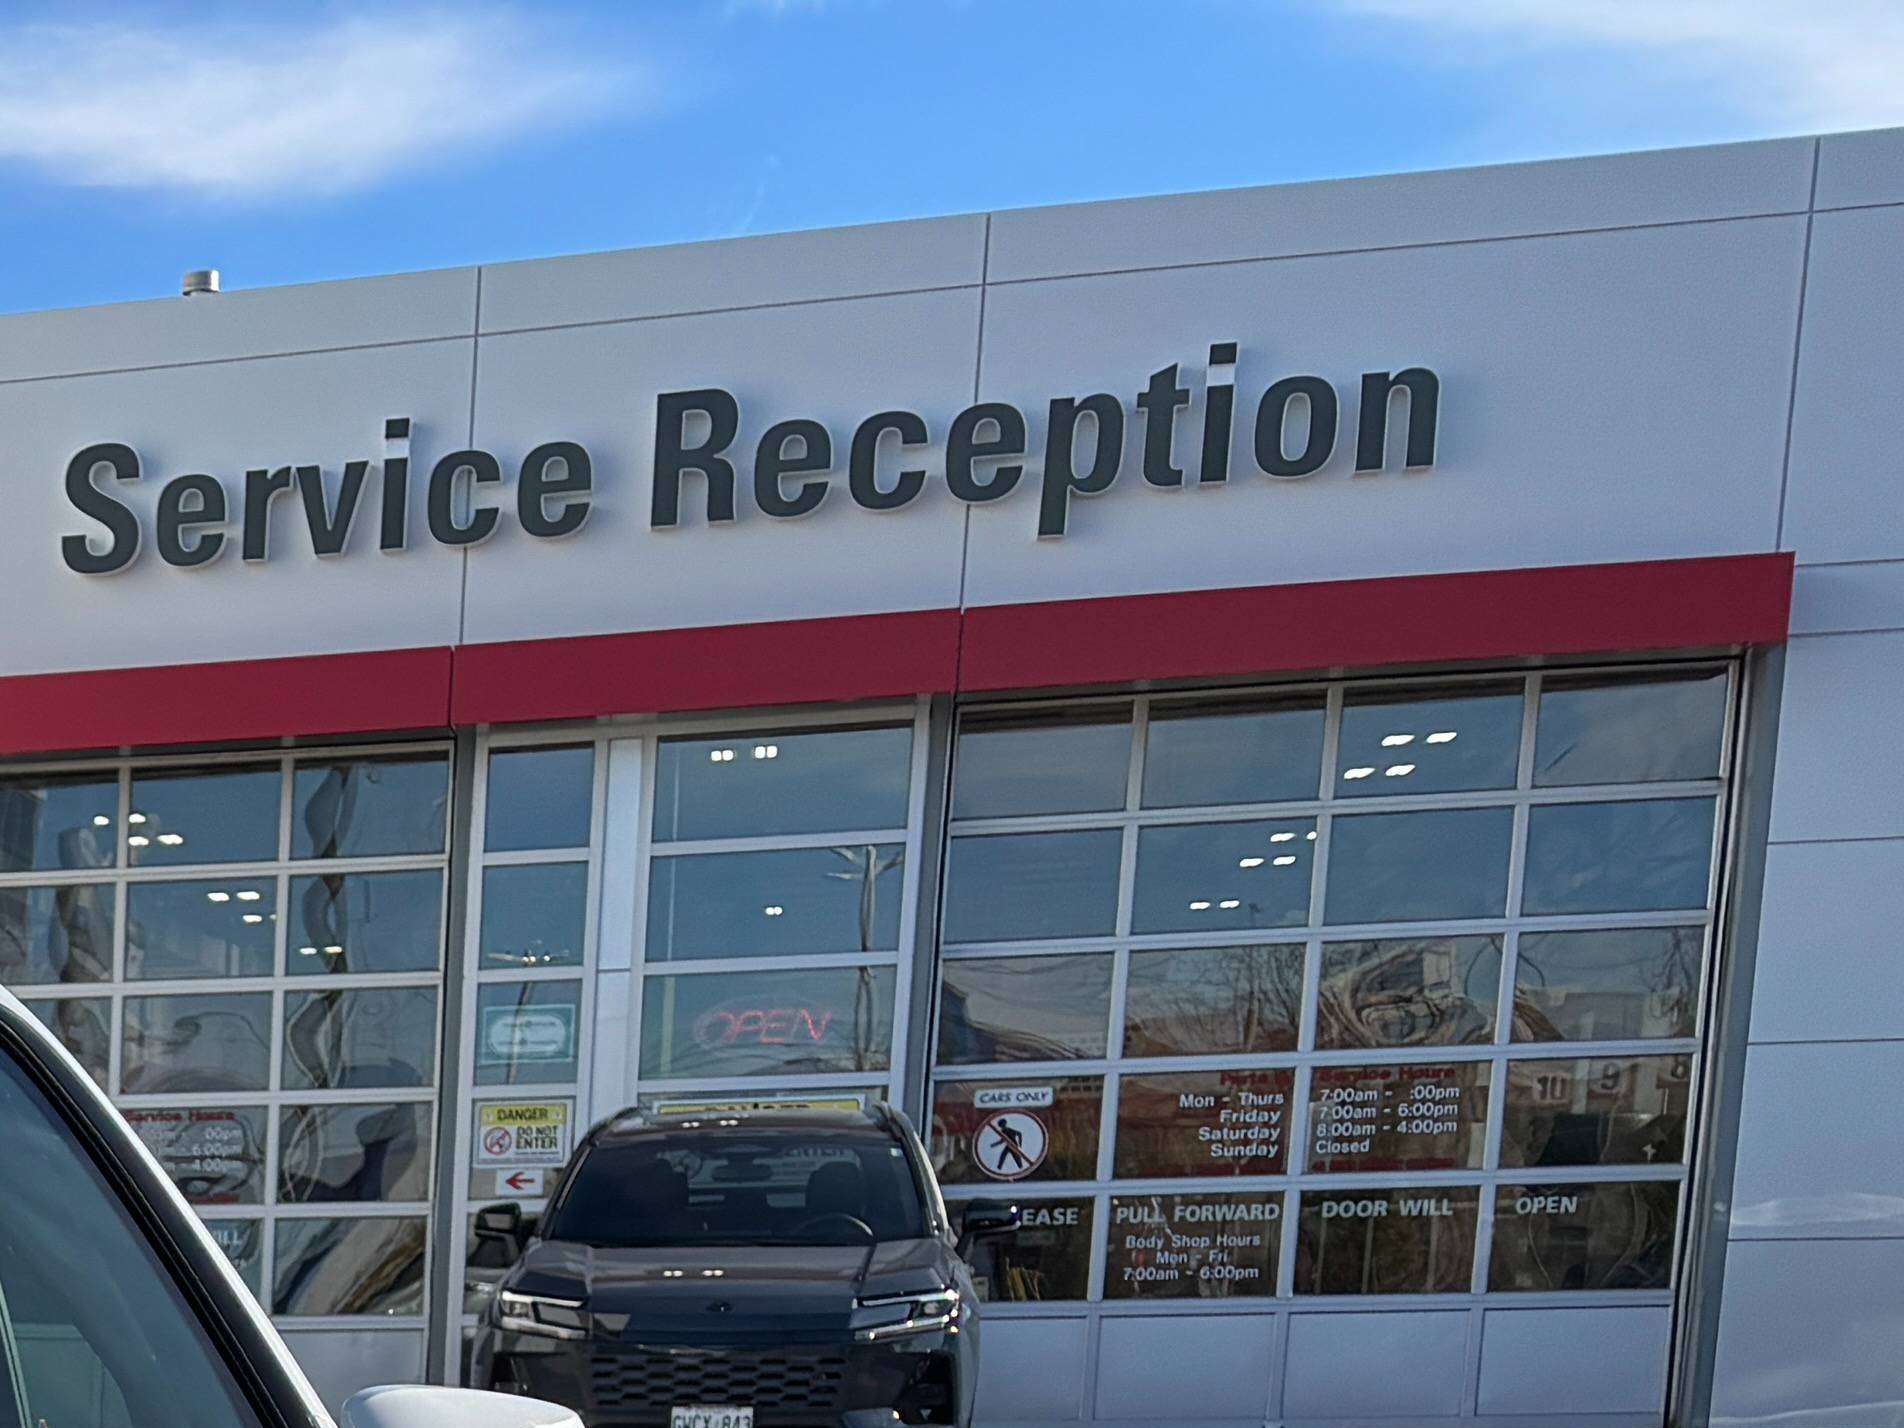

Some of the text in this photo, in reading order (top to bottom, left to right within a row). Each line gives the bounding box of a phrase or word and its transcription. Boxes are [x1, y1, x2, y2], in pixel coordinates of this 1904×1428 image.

[61, 340, 1442, 576] Service Reception
[699, 1008, 833, 1044] OPEN
[979, 1091, 1049, 1103] CARS ONLY
[1179, 1094, 1214, 1108] Mon
[1238, 1092, 1284, 1106] Thurs
[1320, 1088, 1378, 1103] 7:00am
[497, 1108, 548, 1121] DANGER
[1219, 1109, 1281, 1125] Friday
[1319, 1105, 1376, 1120] 7:00am
[1398, 1103, 1458, 1120] 6:00pm
[517, 1125, 558, 1136] DO NOT
[1198, 1126, 1280, 1143] Saturday
[1316, 1123, 1376, 1137] 8:00am
[1397, 1120, 1457, 1137] 4:00pm
[517, 1137, 557, 1149] ENTER
[1210, 1139, 1370, 1159] Sunday Closed
[1022, 1196, 1578, 1226] EASE PULL FORWARD DOOR WILL OPEN
[1126, 1233, 1261, 1251] Body Shop Hours
[1156, 1250, 1188, 1264] Mon
[1208, 1250, 1229, 1263] Fri
[1123, 1266, 1179, 1281] 7:00am
[1200, 1265, 1259, 1282] 6:00pm
